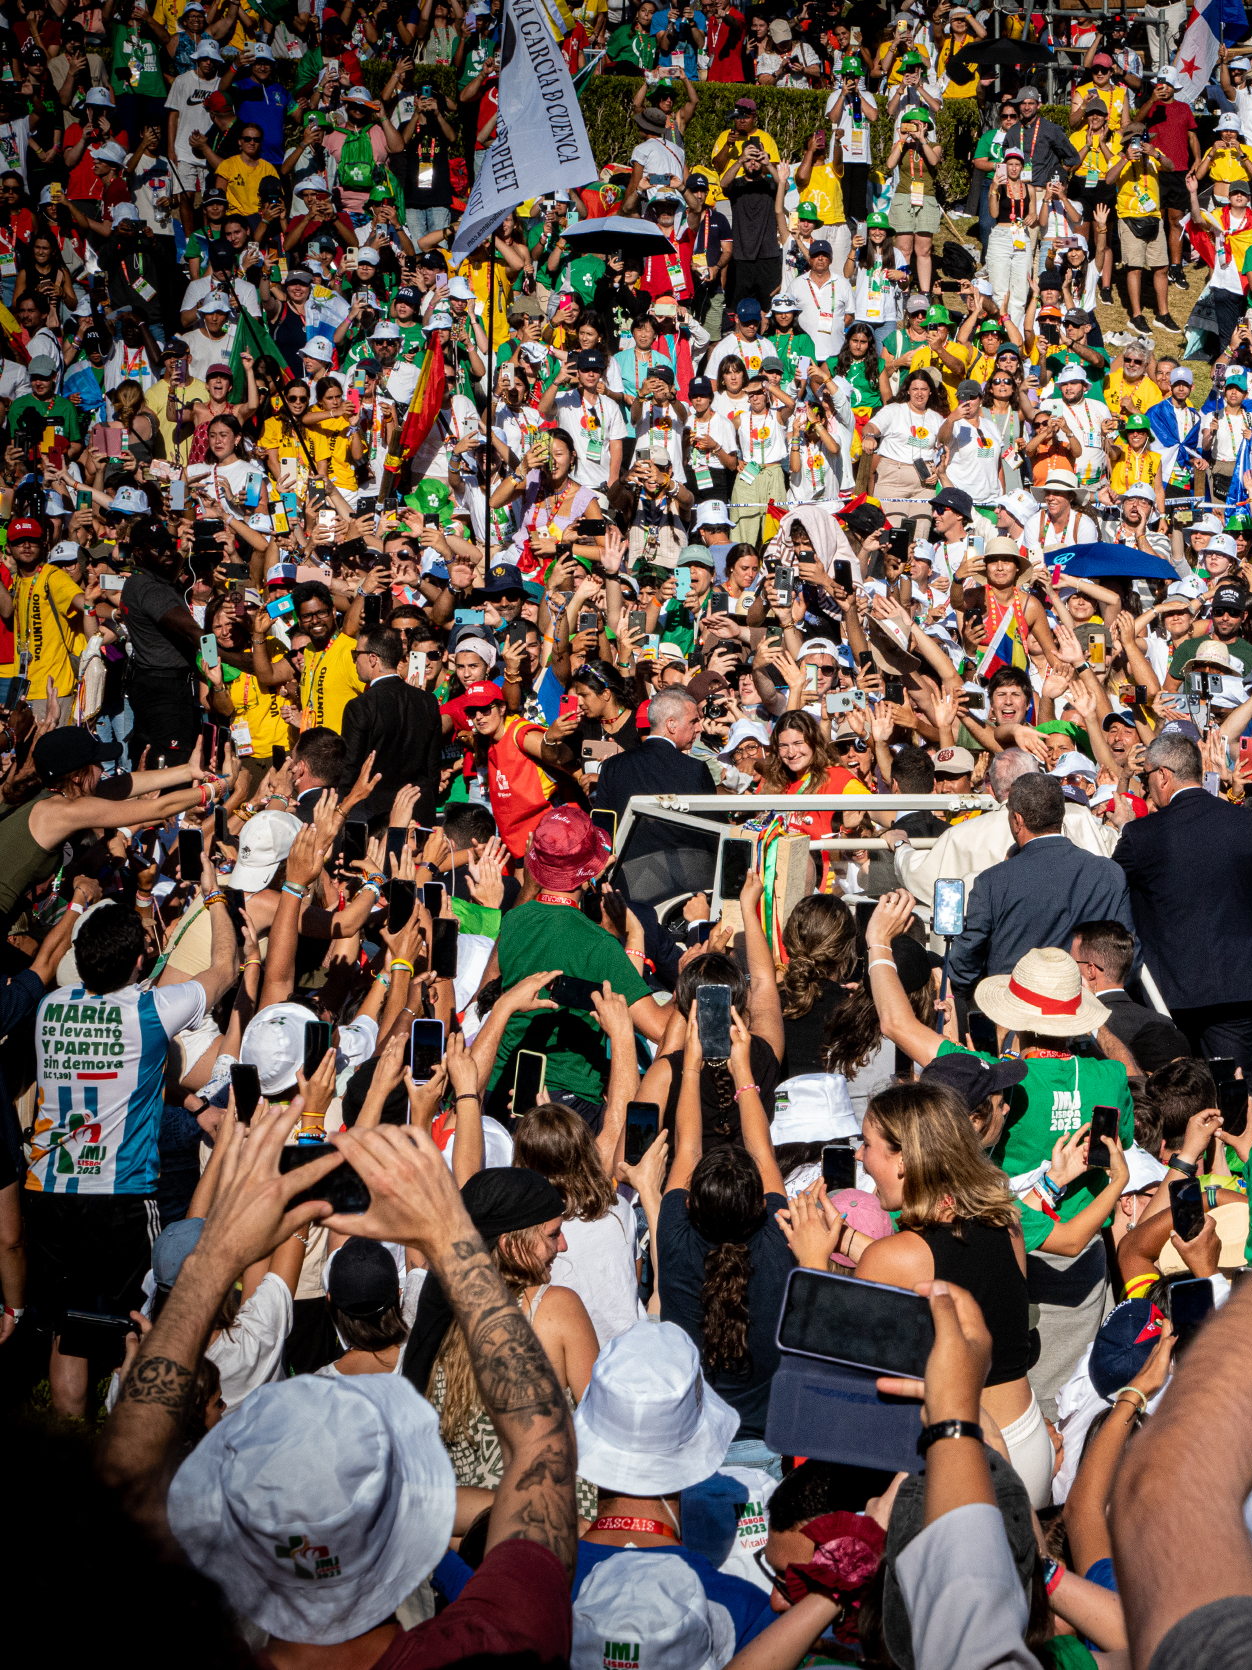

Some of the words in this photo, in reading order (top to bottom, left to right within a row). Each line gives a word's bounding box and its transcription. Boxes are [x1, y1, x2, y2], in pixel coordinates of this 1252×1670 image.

[520, 20, 563, 91] GARCÍA
[546, 103, 581, 165] CUENCA
[32, 593, 44, 662] VOLUNTÁRIO
[316, 667, 327, 731] LUNTÁRIO
[550, 812, 571, 825] Italia
[575, 867, 595, 878] Italia
[541, 894, 572, 906] CASCAIS
[43, 1000, 123, 1025] MARÍA
[42, 1025, 56, 1037] se
[59, 1023, 123, 1038] levantó
[42, 1039, 51, 1055] Y
[53, 1038, 125, 1056] PARTIÓ
[43, 1055, 59, 1070] sin
[62, 1056, 124, 1070] demora
[43, 1070, 53, 1079] (LC
[53, 1071, 72, 1081] 1,39)
[1051, 1090, 1081, 1110] JMJ
[1050, 1110, 1081, 1120] LISBOA
[1049, 1118, 1081, 1132] 2023
[77, 1144, 107, 1162] JMJ
[76, 1166, 101, 1175] 2023
[734, 1501, 764, 1520] JMJ
[597, 1517, 655, 1532] CASCAIS
[736, 1516, 766, 1528] LISBOA
[738, 1523, 767, 1537] 2023
[315, 1556, 340, 1568] JMJ
[315, 1564, 341, 1574] LISBOA
[317, 1569, 342, 1580] 2023
[603, 1640, 640, 1662] JMJ
[602, 1657, 640, 1670] LISBOA
